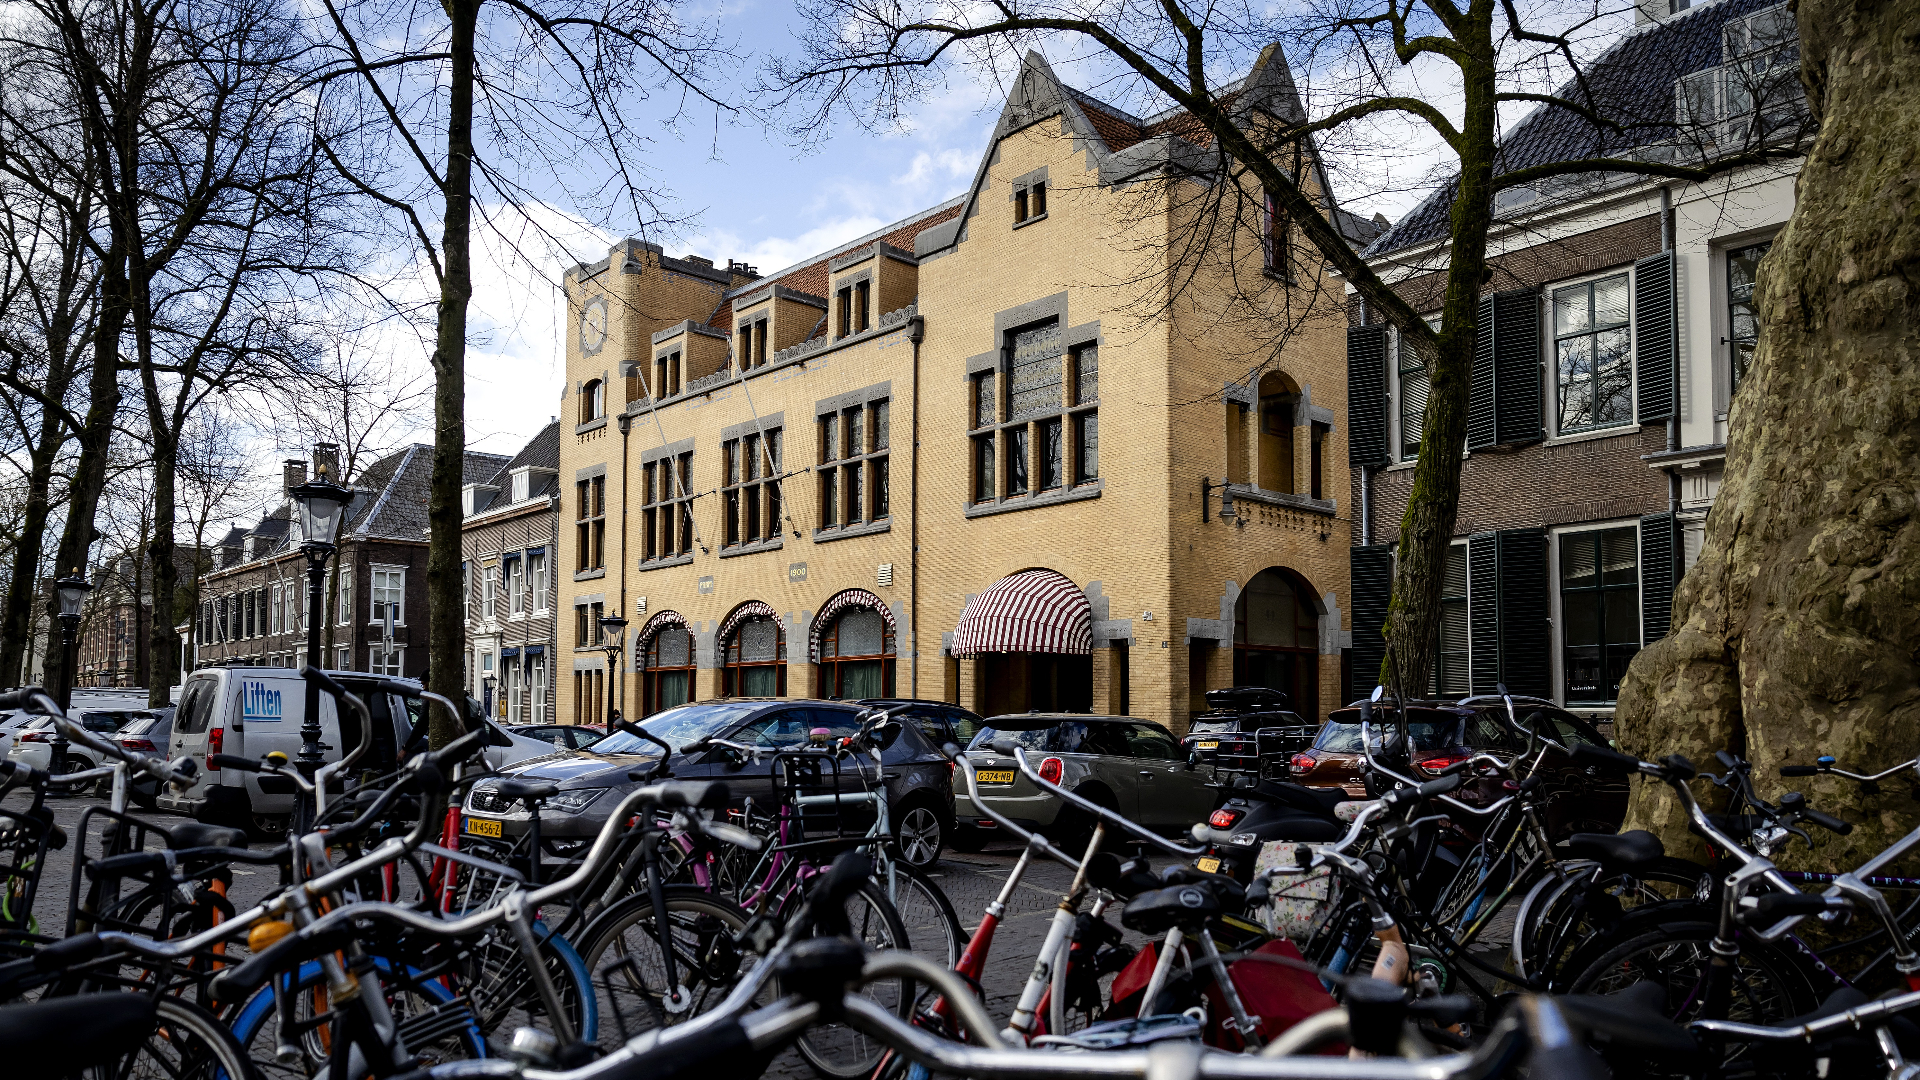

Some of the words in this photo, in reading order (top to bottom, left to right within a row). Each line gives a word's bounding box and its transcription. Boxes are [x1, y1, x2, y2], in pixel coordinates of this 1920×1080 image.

[790, 567, 806, 577] 1900
[243, 681, 282, 716] Liften
[978, 772, 1012, 781] G-374-NB
[469, 820, 501, 836] KN-456-Z
[1803, 871, 1905, 886] BERLEY
